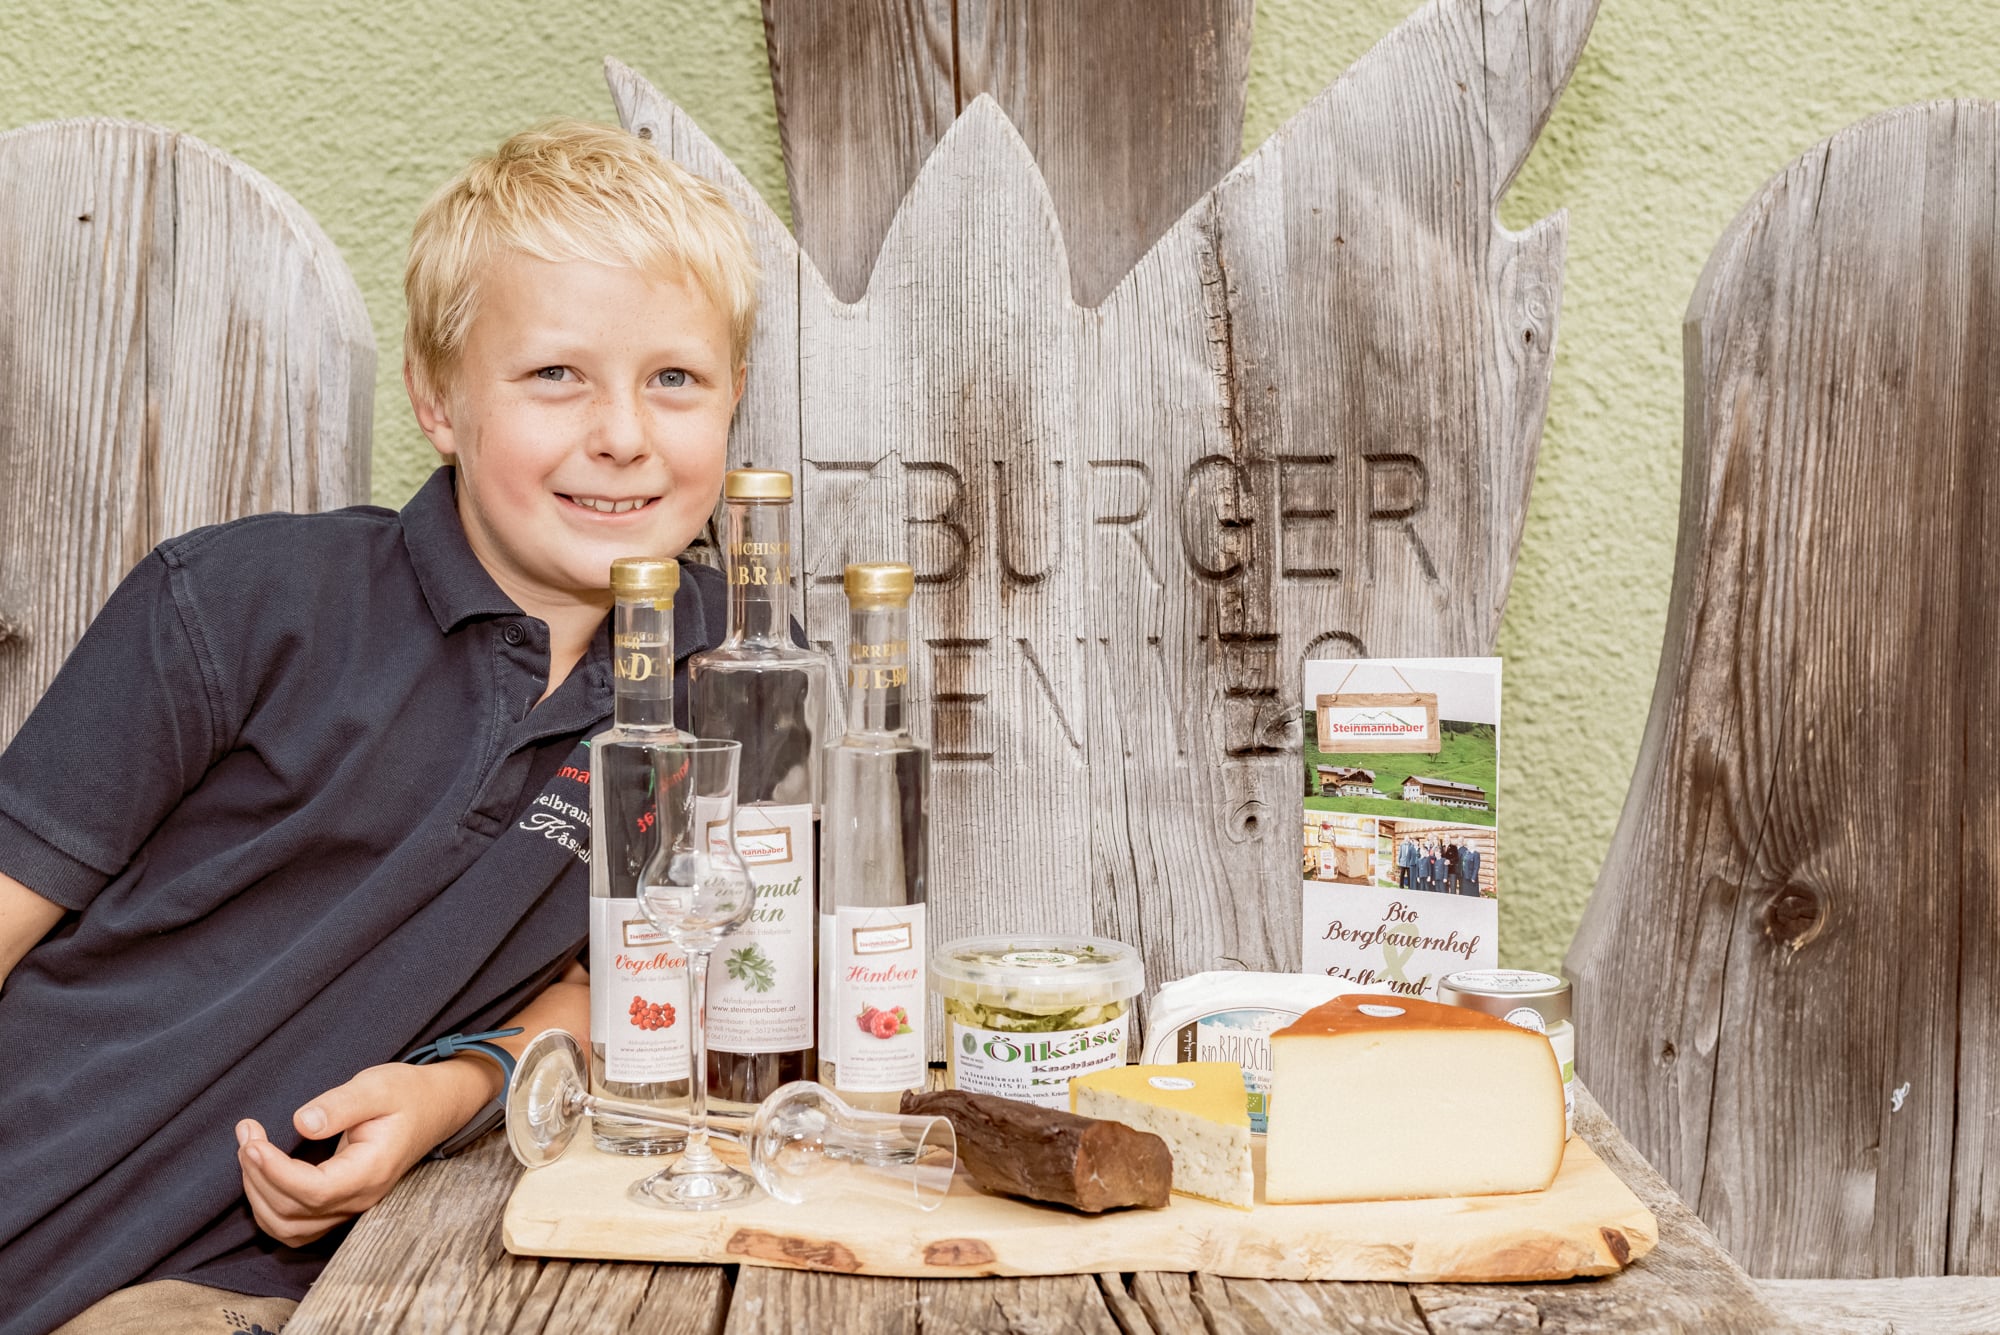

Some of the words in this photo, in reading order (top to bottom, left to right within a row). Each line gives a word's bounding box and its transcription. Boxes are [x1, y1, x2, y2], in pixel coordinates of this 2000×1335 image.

[790, 453, 1446, 592] ZBURGER
[1333, 723, 1424, 732] Steinmannbauer
[756, 875, 803, 898] mut
[750, 903, 785, 922] ein
[1382, 901, 1419, 923] Bio
[1322, 920, 1481, 960] Bergbauernhof
[845, 963, 920, 983] Himbeer
[711, 1003, 796, 1014] www.steinmannbauer.at
[983, 1027, 1121, 1063] Ölkäse
[1031, 1052, 1117, 1073] Knoblauch
